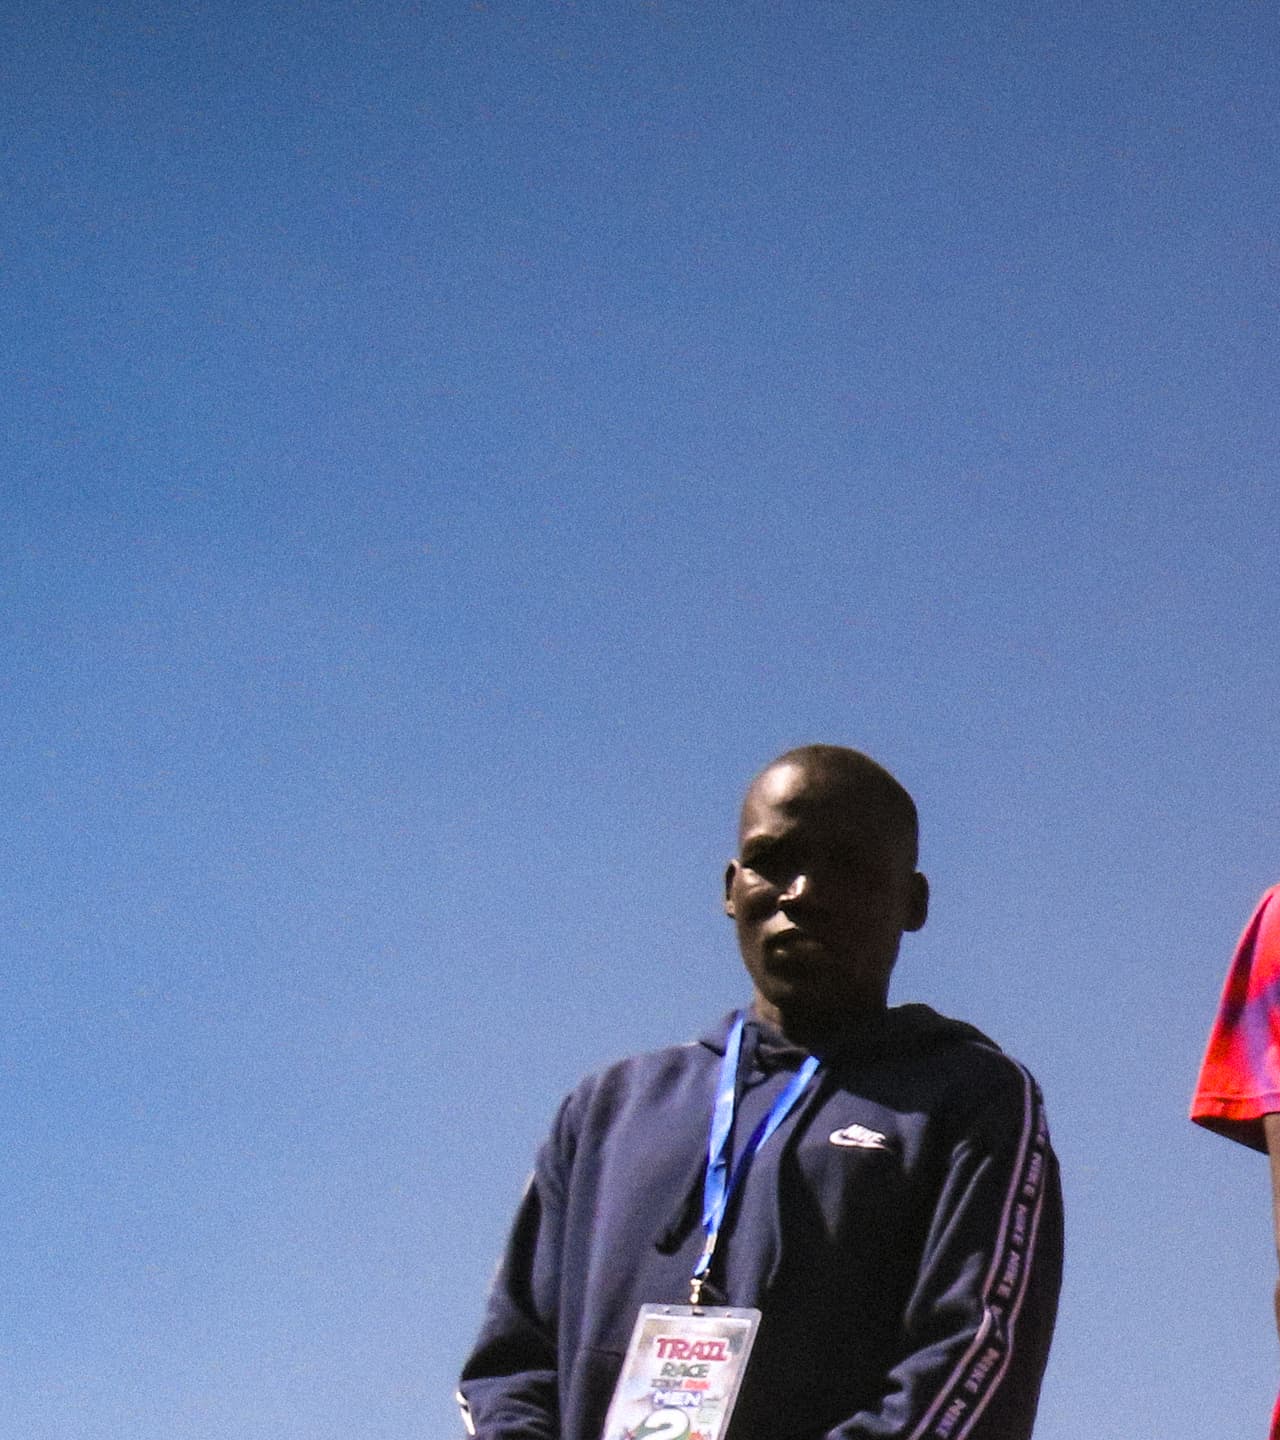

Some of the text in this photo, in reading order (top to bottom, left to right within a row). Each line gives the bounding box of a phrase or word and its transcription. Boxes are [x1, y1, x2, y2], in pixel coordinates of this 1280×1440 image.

[656, 1337, 728, 1361] TRAIL
[660, 1361, 710, 1378] RACE
[653, 1390, 702, 1407] MEN
